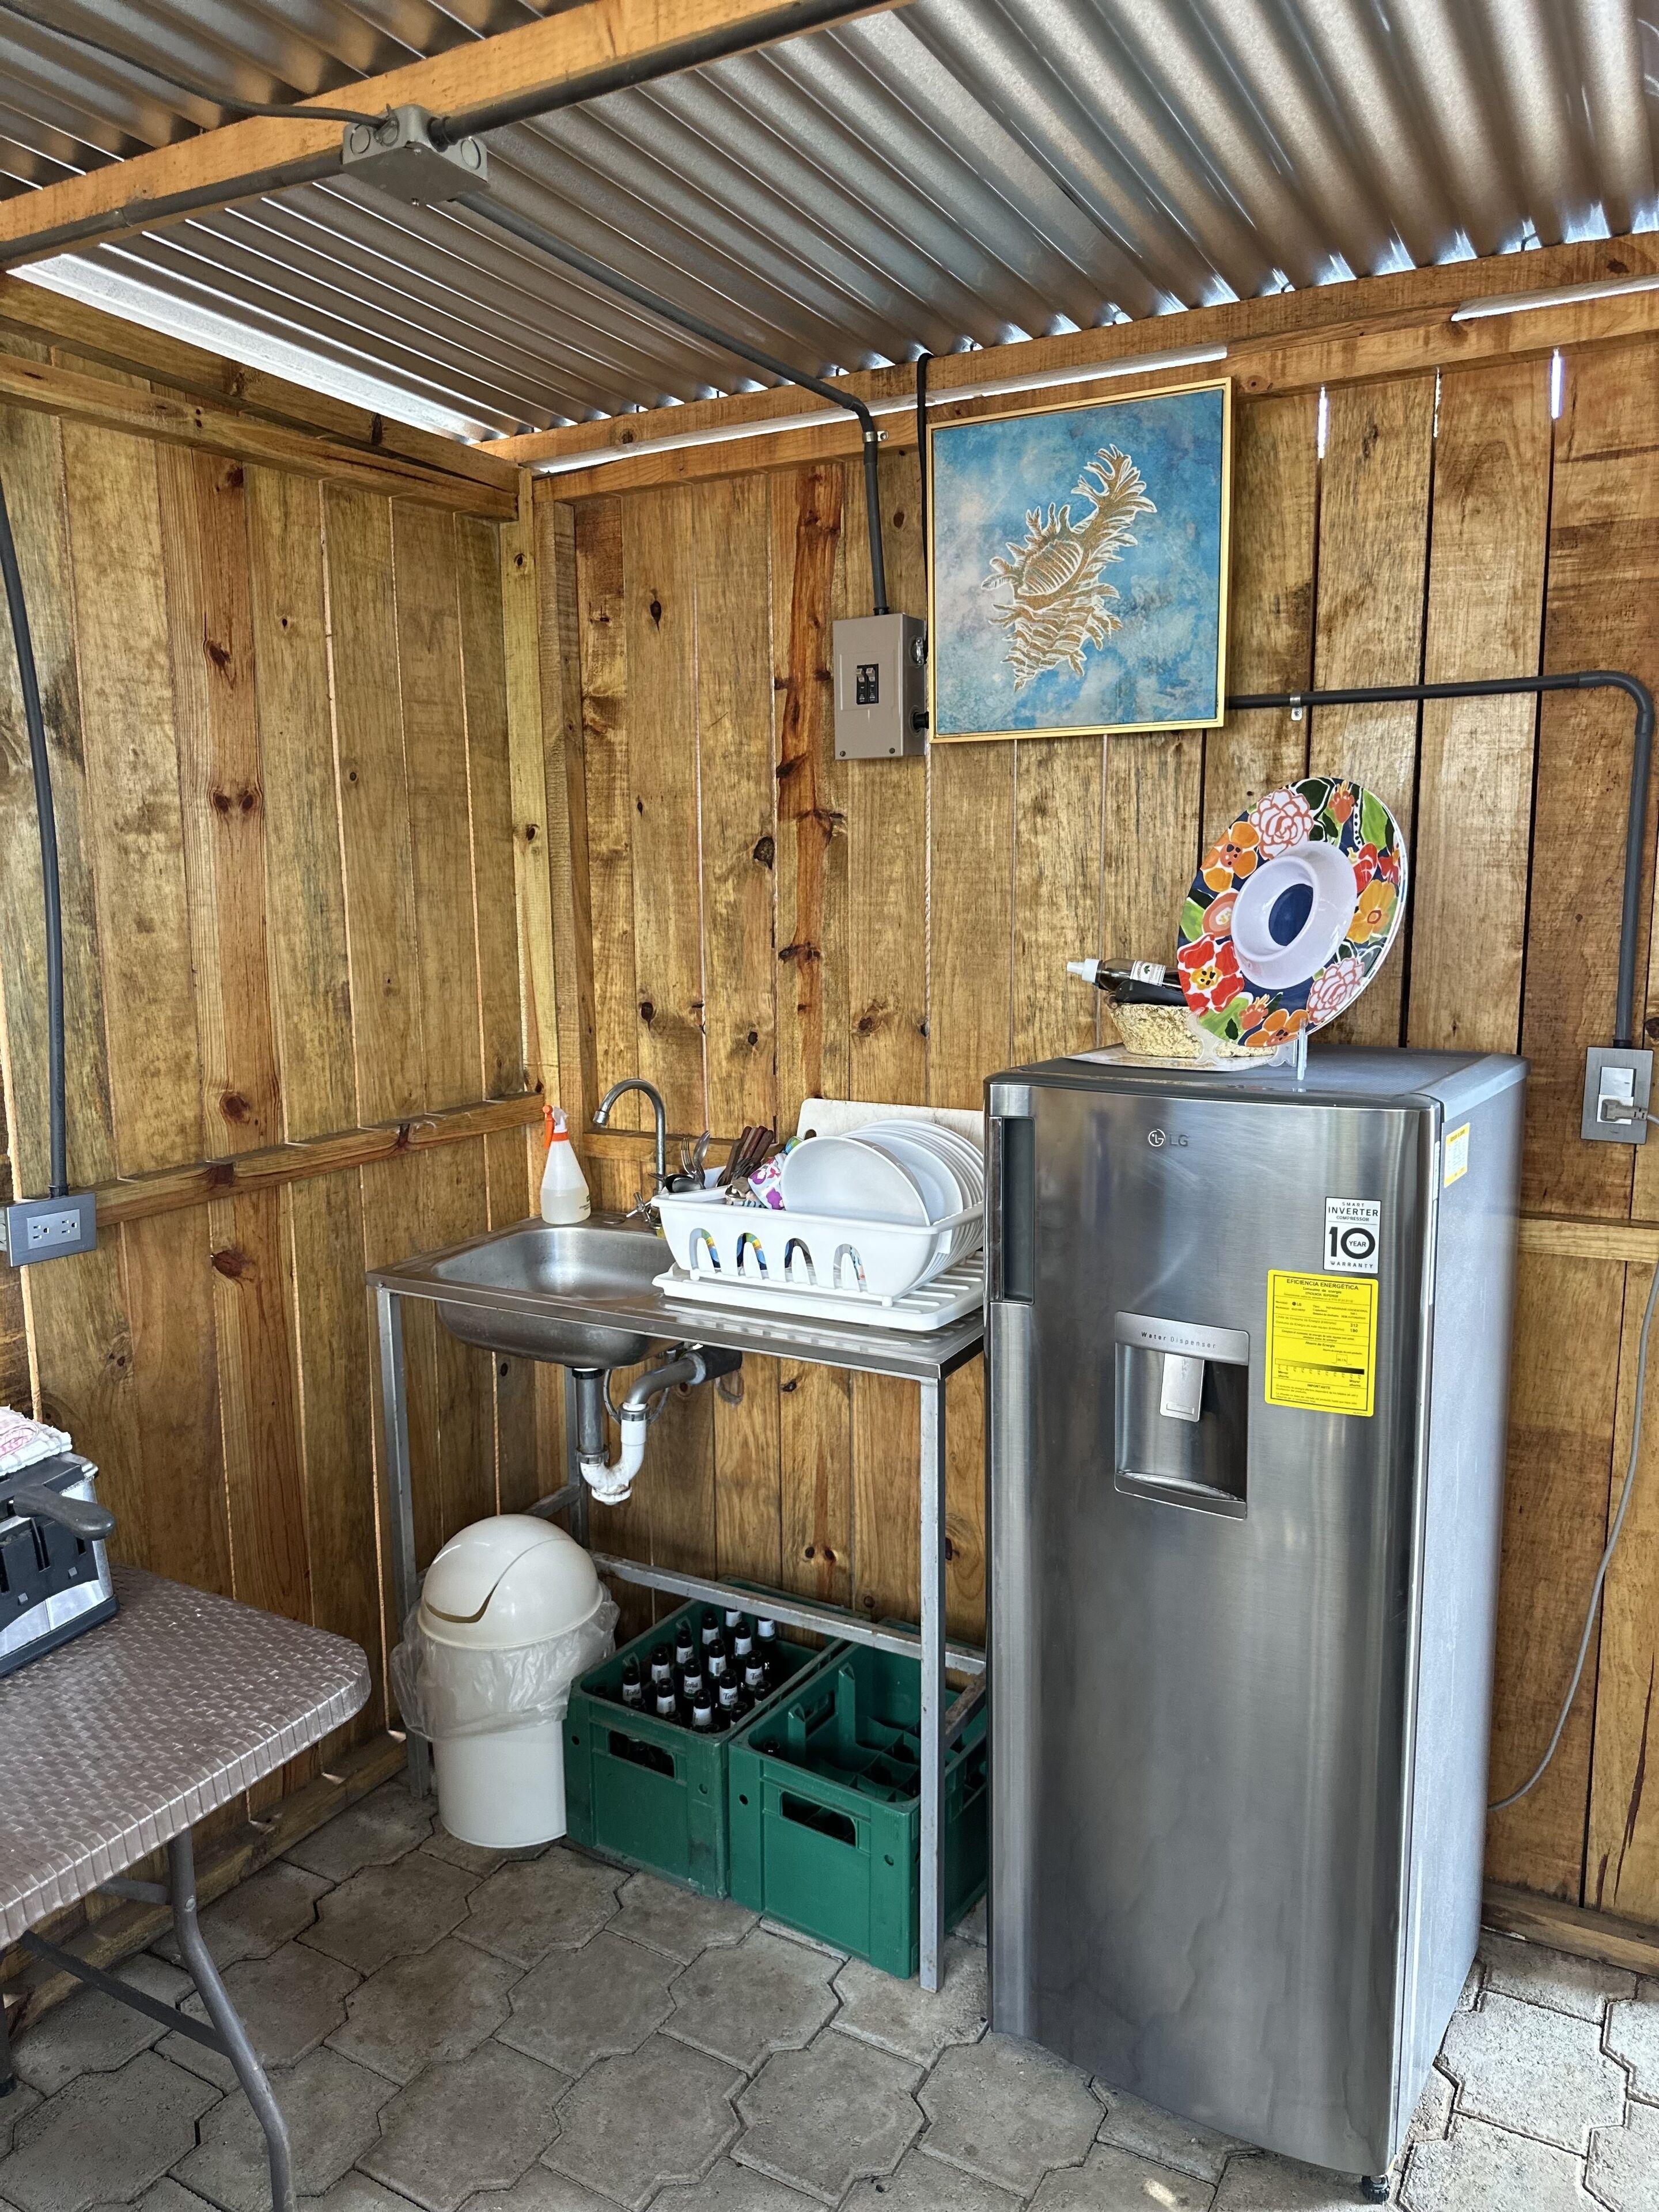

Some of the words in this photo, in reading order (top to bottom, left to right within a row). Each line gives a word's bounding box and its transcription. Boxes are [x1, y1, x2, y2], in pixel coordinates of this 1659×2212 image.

[1169, 1133, 1189, 1147] LG
[1328, 1207, 1378, 1217] INVERTER
[1328, 1226, 1376, 1259] 10
[1330, 1260, 1373, 1268] WARRANTY
[1286, 1278, 1319, 1287] EFICIENCIA
[1320, 1282, 1359, 1290] ENERGÉTICA
[1141, 1331, 1166, 1341] Water
[1170, 1336, 1217, 1349] Dispenser
